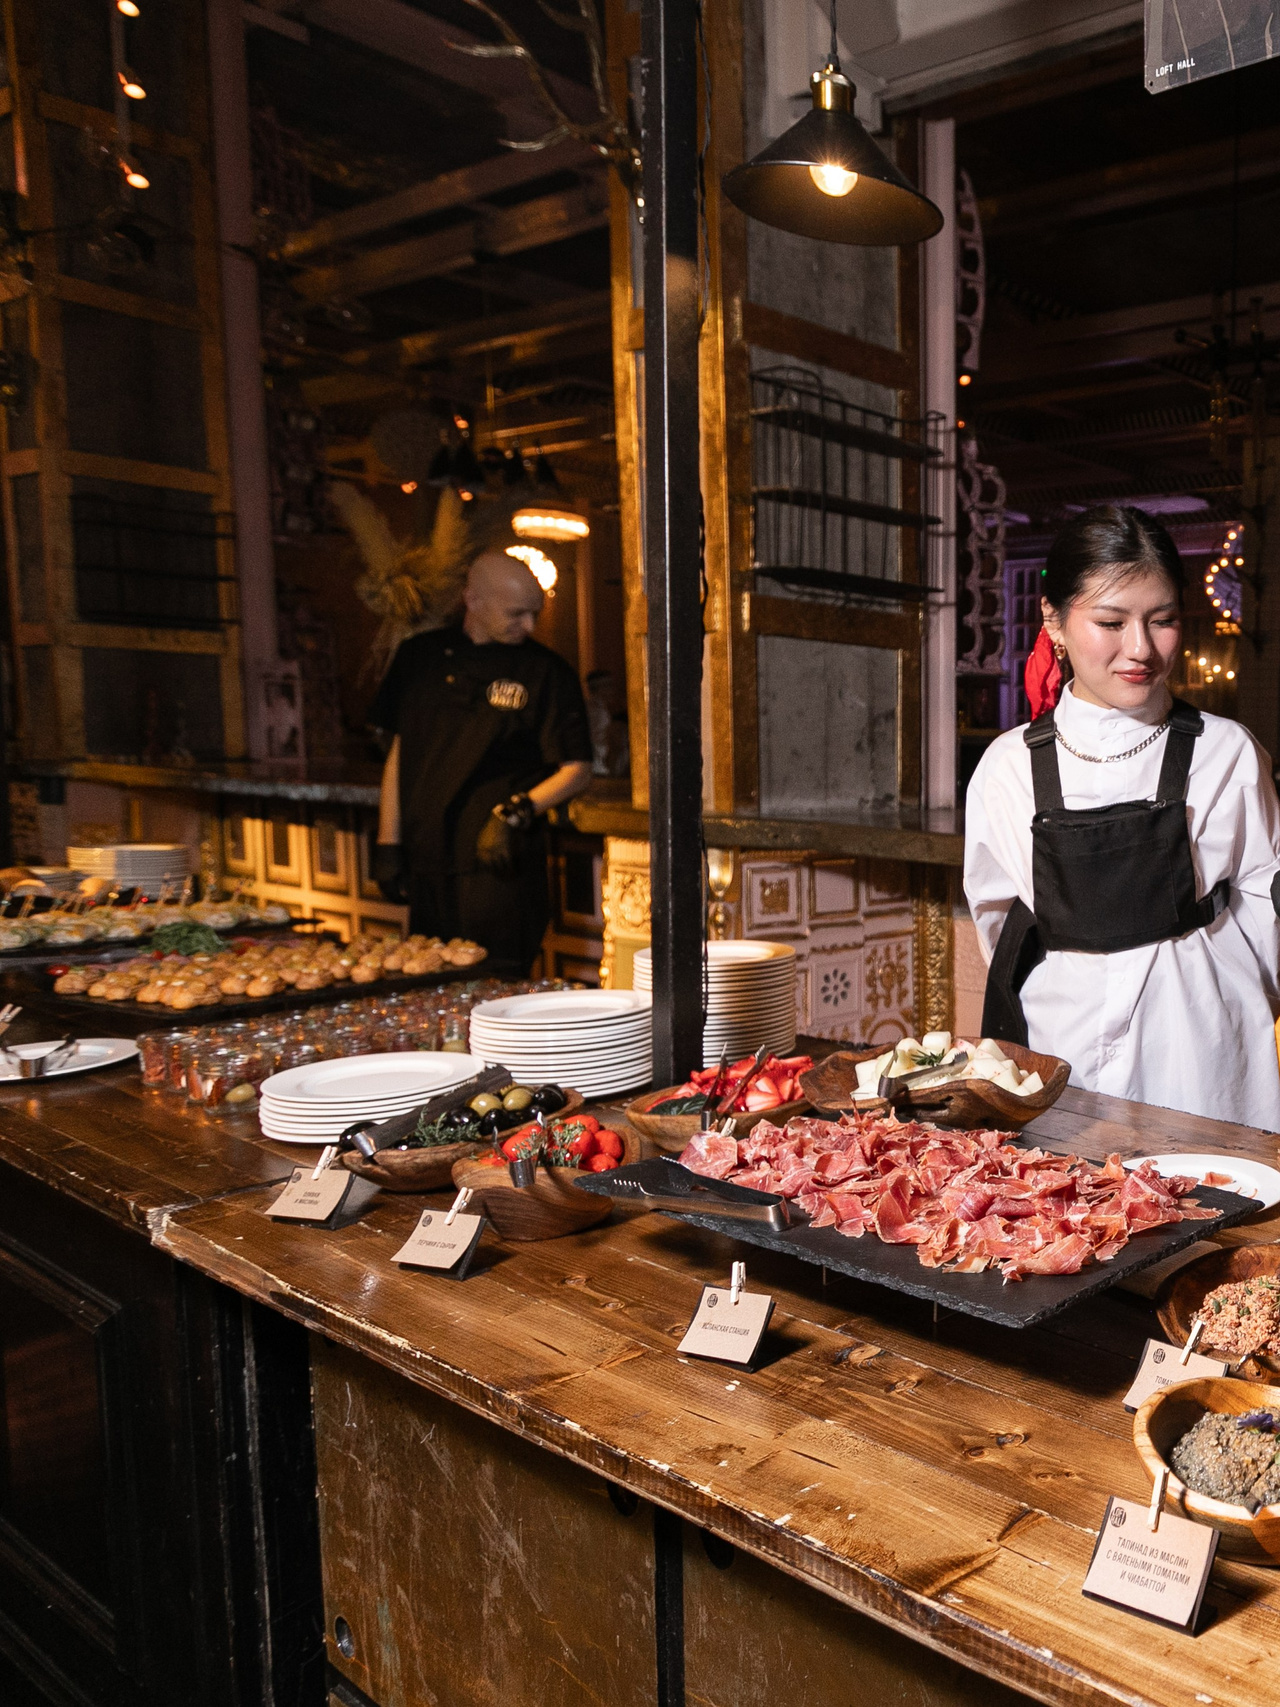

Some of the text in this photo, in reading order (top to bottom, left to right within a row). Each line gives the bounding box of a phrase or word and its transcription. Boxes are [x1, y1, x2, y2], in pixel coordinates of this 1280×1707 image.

[1155, 57, 1196, 78] LOFT HALL
[1117, 1537, 1189, 1569] ТАПИНАД ИЗ МАСЛИН
[1106, 1549, 1191, 1586] С ВЯЛЕНЫМИ ТОМАТАМИ
[1120, 1569, 1167, 1594] И ЧИАБАТТОЙ
